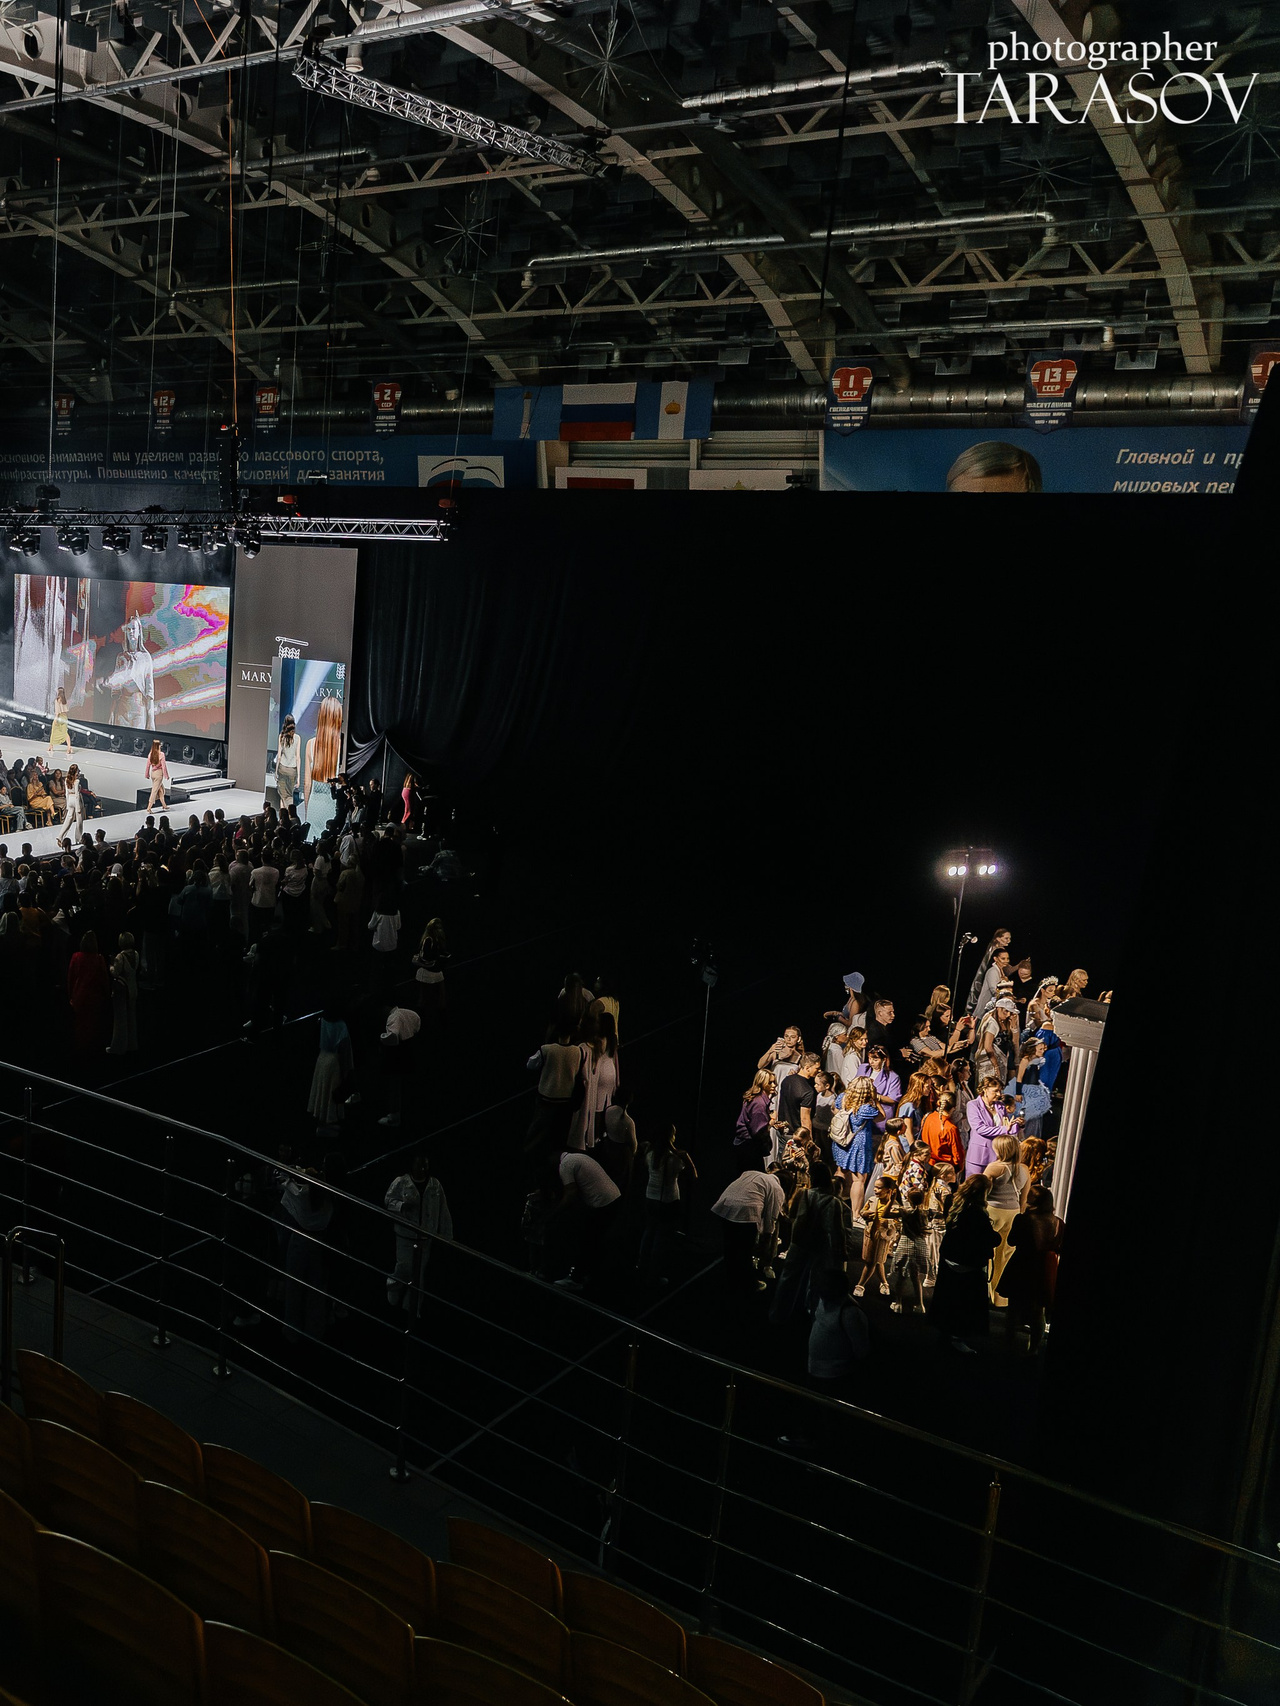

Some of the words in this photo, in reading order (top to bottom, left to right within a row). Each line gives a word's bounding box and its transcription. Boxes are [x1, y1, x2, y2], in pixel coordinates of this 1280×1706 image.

[848, 374, 855, 389] 1
[1043, 367, 1063, 382] 13
[383, 388, 392, 401] 2
[1041, 384, 1061, 392] СССР
[159, 395, 169, 407] 12
[261, 392, 274, 404] 20
[50, 451, 104, 463] внимание
[113, 452, 131, 463] мы
[135, 452, 184, 465] уделяем
[254, 450, 326, 462] массового
[332, 450, 385, 465] спорта,
[1115, 448, 1195, 464] Главной
[1203, 452, 1216, 465] и
[97, 467, 168, 480] Повышению
[174, 469, 219, 480] качеств
[329, 469, 385, 481] занятия
[1113, 480, 1201, 494] мировых
[241, 669, 272, 683] MARY
